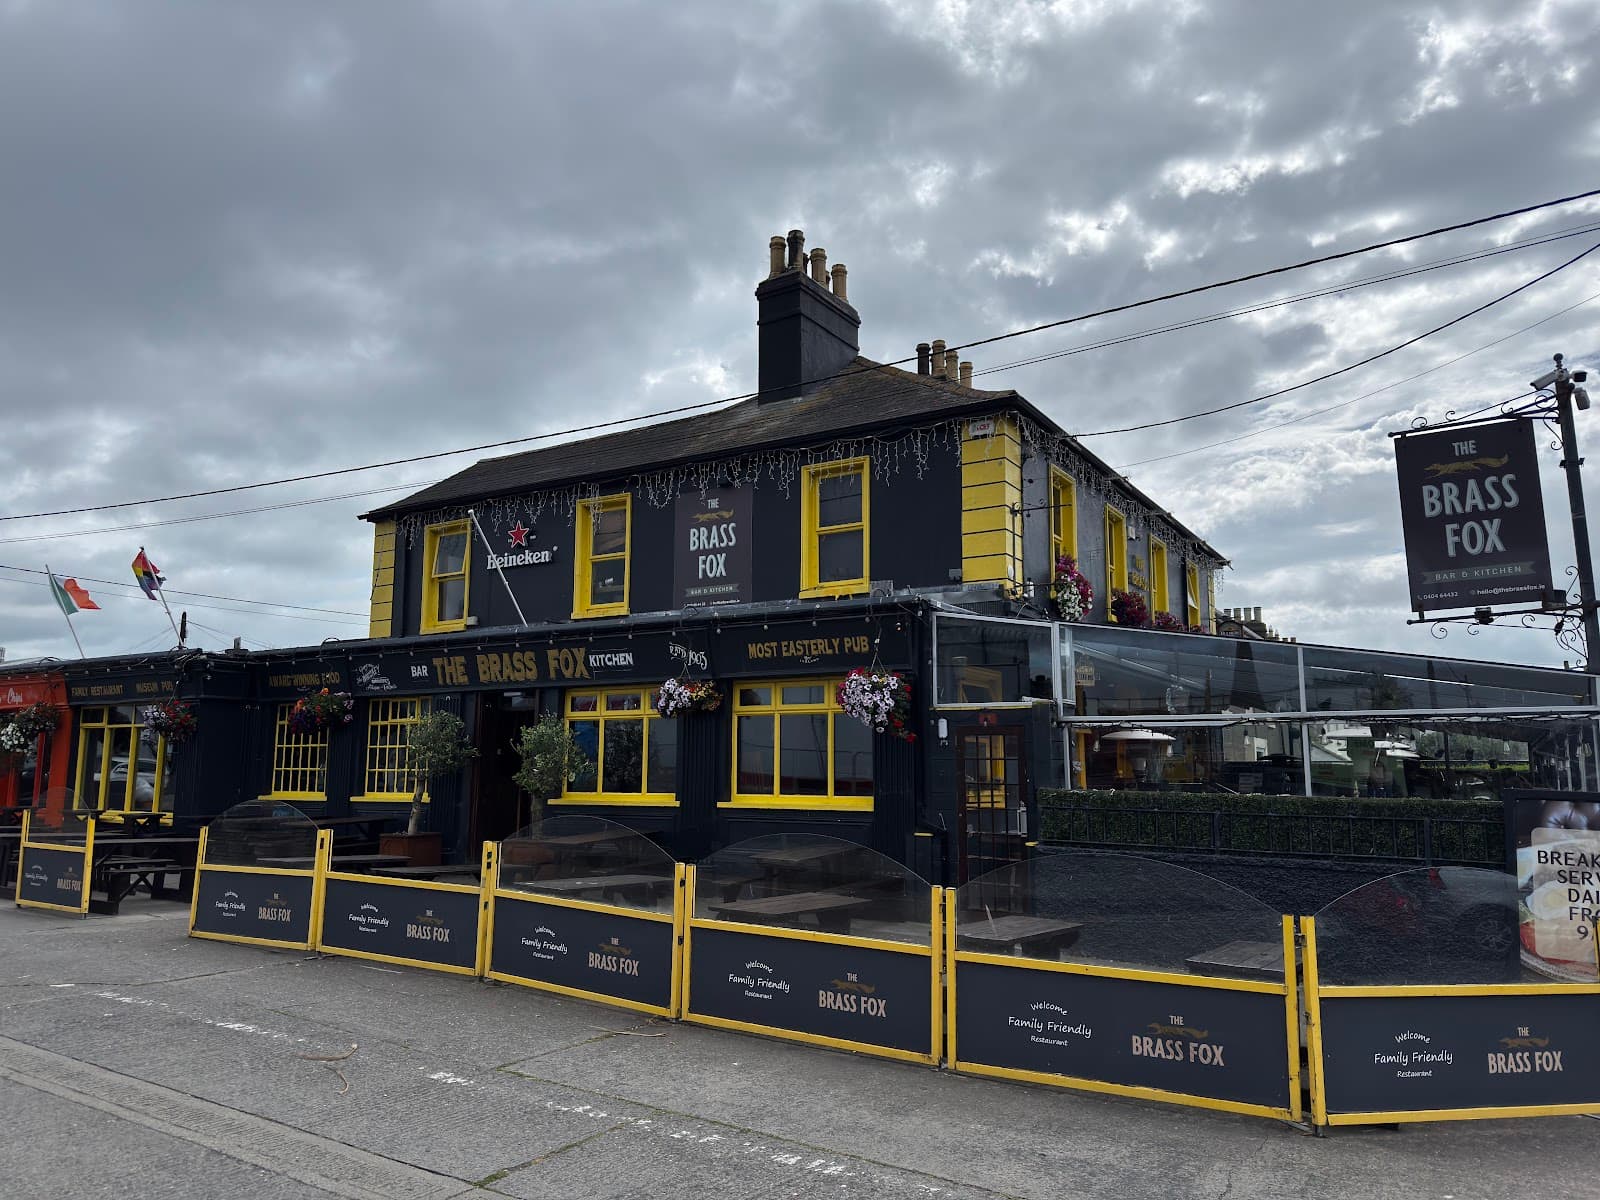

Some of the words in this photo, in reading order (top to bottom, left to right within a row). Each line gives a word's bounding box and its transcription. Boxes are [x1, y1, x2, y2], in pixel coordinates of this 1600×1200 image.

[1452, 440, 1477, 456] THE
[707, 498, 719, 509] THE
[1422, 473, 1519, 518] BRASS
[689, 522, 737, 551] BRASS
[1445, 518, 1506, 557] FOX
[487, 549, 550, 570] Heineken
[698, 553, 727, 579] FOX
[1435, 572, 1456, 581] BAR
[1474, 566, 1521, 577] KITCHEN
[748, 641, 778, 659] MOST
[782, 638, 840, 657] EASTERLY
[843, 636, 869, 654] PUB
[432, 656, 470, 686] THE
[476, 651, 539, 684] BRASS
[547, 648, 591, 680] FOX
[589, 652, 634, 667] KITCHEN
[687, 650, 708, 670] 1903
[410, 665, 429, 677] BAR
[258, 907, 277, 920] BRASS
[278, 908, 292, 922] FOX
[348, 913, 367, 924] Family
[367, 916, 389, 928] Friendly
[406, 923, 432, 940] BRASS
[432, 926, 450, 943] FOX
[534, 925, 556, 938] Welcome
[521, 937, 542, 950] Family
[542, 941, 568, 955] Friendly
[588, 952, 618, 972] BRASS
[619, 957, 639, 977] FOX
[745, 959, 773, 974] Welcome
[728, 973, 755, 988] Family
[757, 977, 790, 993] Friendly
[847, 972, 858, 983] THE
[744, 990, 773, 1000] Restaurant
[818, 990, 857, 1013] BRASS
[860, 996, 887, 1018] FOX
[1030, 1000, 1068, 1016] Welcome
[1008, 1016, 1043, 1032] Family
[1047, 1020, 1092, 1039] Friendly
[1169, 1015, 1184, 1026] THE
[1395, 1030, 1431, 1044] Welcome
[1517, 1027, 1530, 1037] THE
[1030, 1035, 1068, 1047] Restaurant
[1131, 1035, 1184, 1061] BRASS
[1189, 1042, 1225, 1067] FOX
[1374, 1051, 1408, 1066] Family
[1412, 1049, 1453, 1065] Friendly
[1487, 1051, 1531, 1074] BRASS
[1534, 1051, 1563, 1073] FOX
[1397, 1069, 1433, 1078] Restaurant
